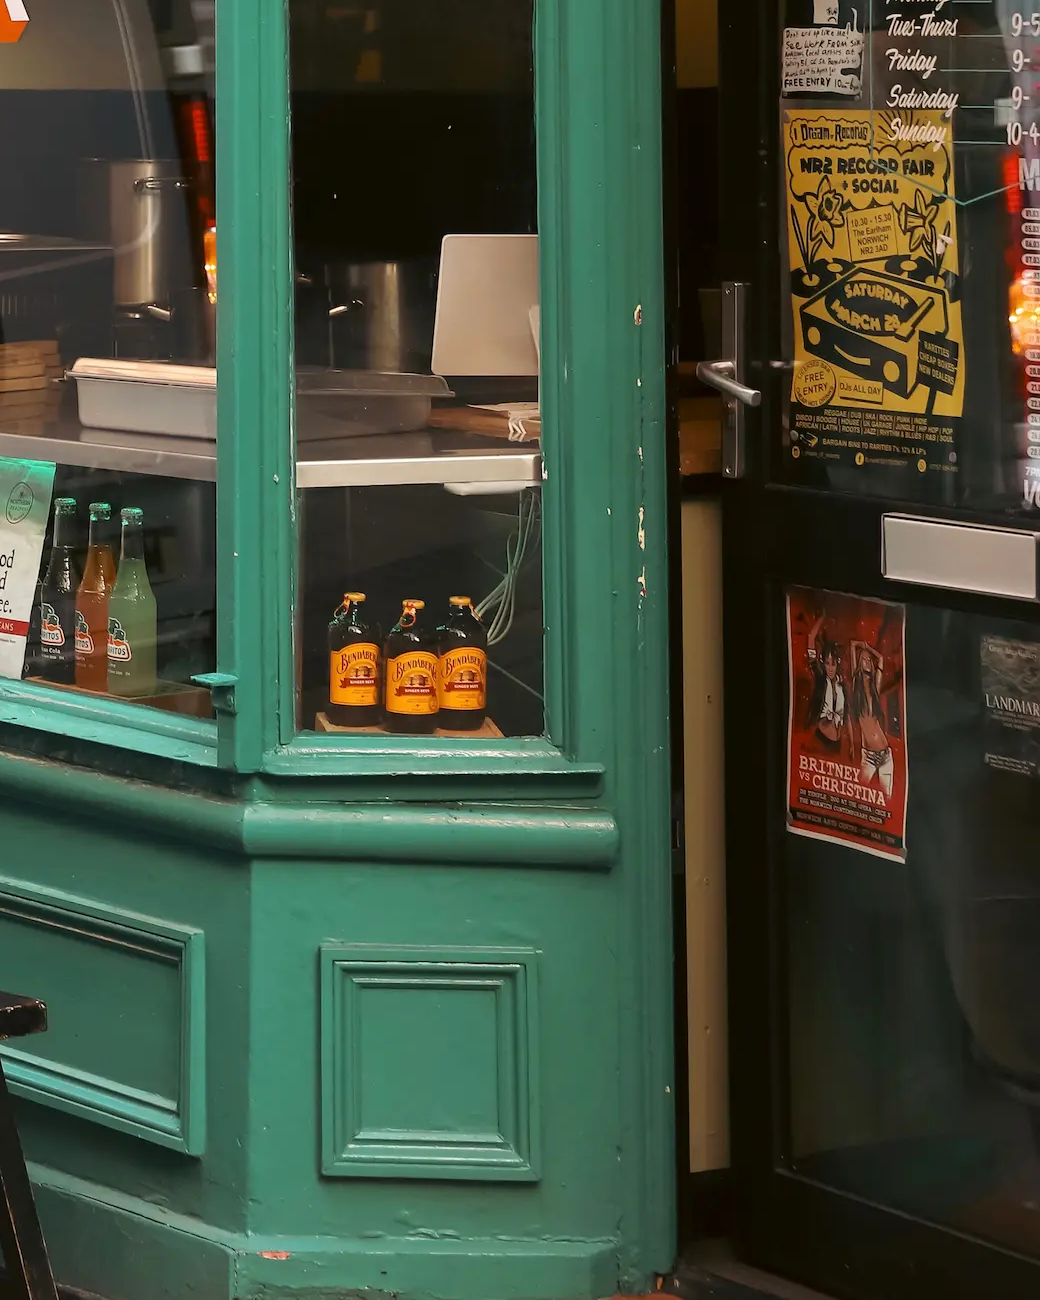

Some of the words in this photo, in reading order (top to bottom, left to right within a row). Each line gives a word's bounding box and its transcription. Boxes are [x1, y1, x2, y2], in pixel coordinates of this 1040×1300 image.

[885, 11, 957, 38] Tues-Thurs
[885, 48, 937, 79] Friday
[784, 78, 804, 88] FREE
[806, 77, 831, 87] ENTRY
[886, 84, 959, 118] Saturday
[887, 118, 948, 153] Sunday
[800, 157, 833, 175] NR2
[837, 157, 899, 176] RECORD
[902, 158, 935, 177] FAIR
[852, 178, 899, 194] SOCIAL
[850, 217, 868, 228] 10.30
[874, 213, 892, 224] 15.30
[852, 228, 864, 237] The
[865, 225, 892, 236] Earlham
[857, 234, 889, 246] NORWICH
[860, 246, 874, 256] NR2
[875, 244, 889, 254] 3AD
[843, 282, 909, 310] SATURDAY
[831, 299, 881, 332] MARCH
[919, 351, 936, 364] CHEAP
[937, 358, 955, 373] BOXES
[804, 371, 824, 383] FREE
[919, 363, 931, 376] NEW
[932, 368, 954, 386] DEALERS
[803, 382, 828, 396] ENTRY
[840, 382, 852, 392] DJs
[853, 382, 867, 393] ALL
[867, 384, 881, 396] DAY
[795, 413, 812, 421] DISCO
[815, 416, 838, 425] BOOGIE
[840, 418, 859, 427] HOUSE
[871, 422, 893, 430] GARAGE
[895, 423, 915, 432] JUNGLE
[823, 409, 847, 418] REGGAE
[879, 414, 893, 422] ROCK
[896, 415, 910, 423] PUNK
[795, 421, 819, 430] AFRICAN
[821, 423, 838, 431] LATIN
[841, 425, 860, 434] ROOTS
[863, 428, 876, 436] JAZZ
[904, 432, 922, 440] BLUES
[939, 435, 954, 443] SOUL
[821, 438, 847, 447] BARGAIN
[848, 440, 861, 449] BINS
[869, 443, 892, 452] RARITIES
[798, 755, 861, 783] BRITNEY
[798, 770, 810, 781] VS
[812, 775, 886, 807] CHRISTINA
[809, 799, 833, 811] NORWICH
